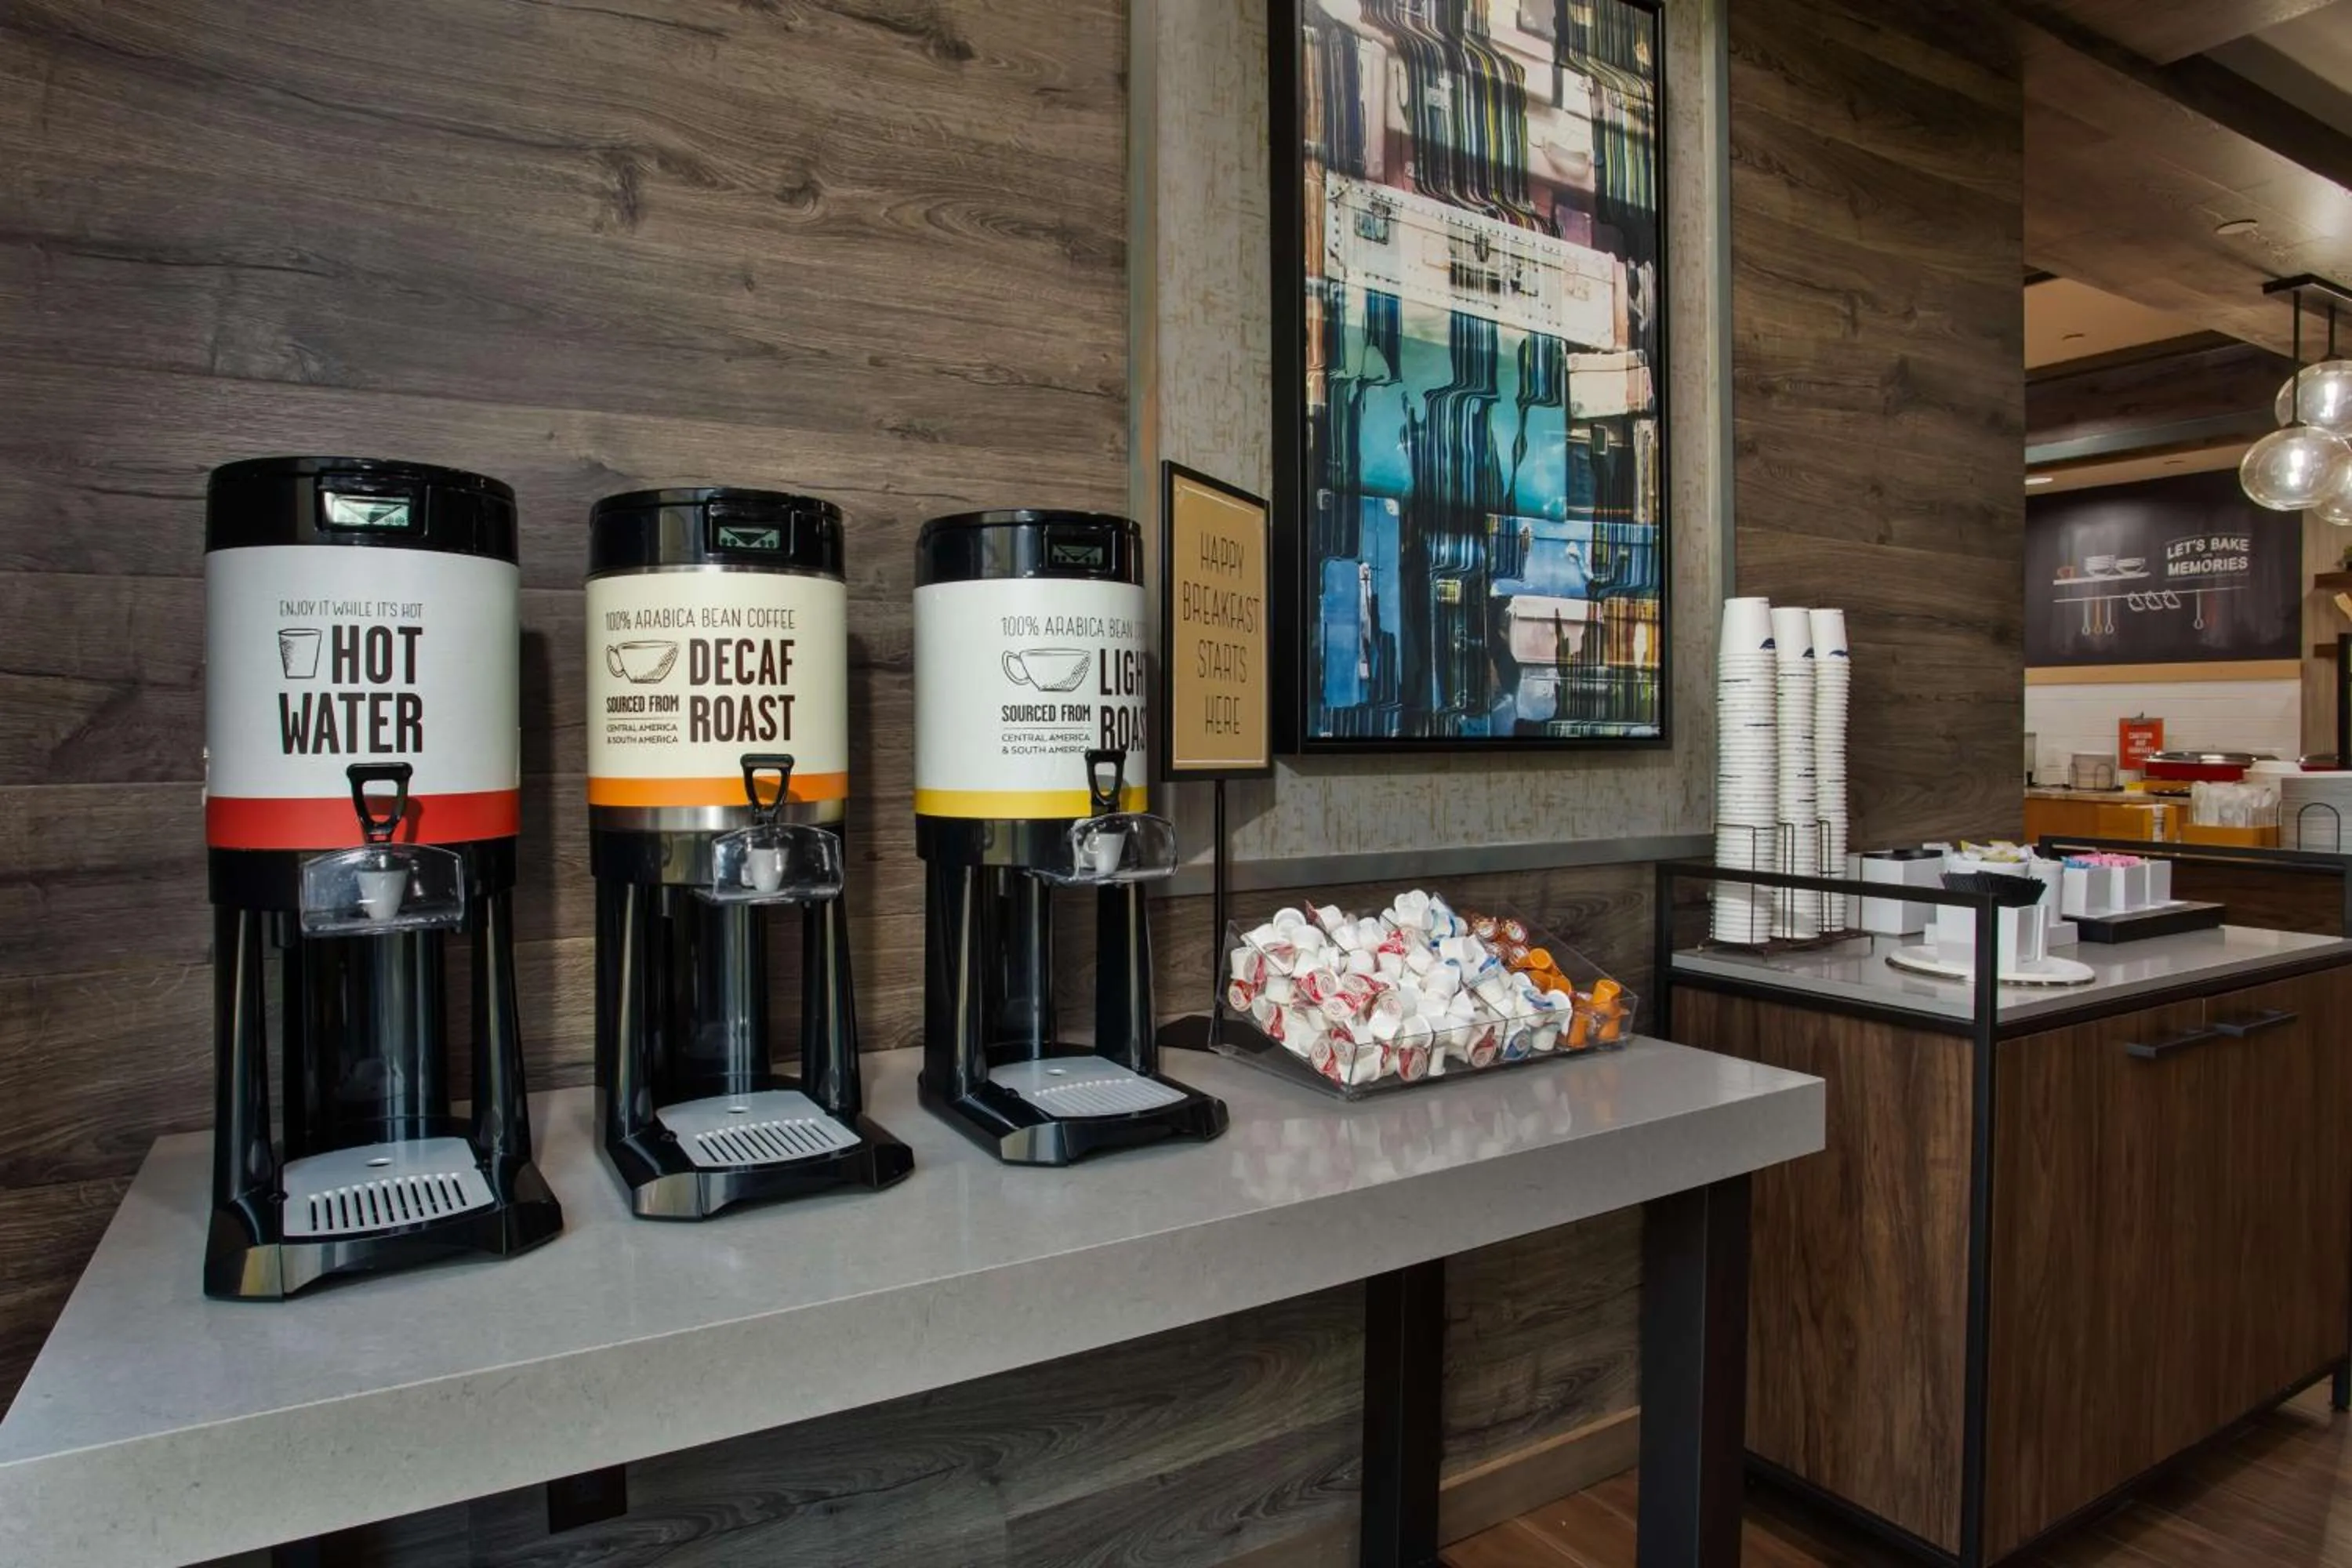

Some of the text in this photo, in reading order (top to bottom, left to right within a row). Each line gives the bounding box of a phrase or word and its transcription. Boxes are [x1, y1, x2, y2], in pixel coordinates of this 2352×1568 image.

[1200, 531, 1244, 579] HAPPY
[2166, 537, 2249, 560] LET'S BAKE
[2167, 556, 2249, 577] MEMORIES
[279, 600, 423, 619] ENJOY IT WHILE IT'S HOT
[606, 608, 796, 631] 100% ARABICA BEAN COFFEE
[1182, 580, 1261, 633] BREAKFAST
[1000, 615, 1040, 637] 100%
[1044, 615, 1105, 637] ARABICA
[1109, 618, 1133, 639] BEAN
[332, 625, 423, 684] HOT
[689, 637, 796, 686] DECAF
[1197, 639, 1247, 684] STARTS
[1100, 648, 1147, 696] LIGH
[606, 694, 680, 713] SOURCED FROM
[689, 694, 796, 743] ROAST
[1001, 704, 1091, 722] SOURCED FROM
[1205, 695, 1241, 735] HERE
[278, 692, 423, 755] WATER
[639, 723, 678, 731] AMERICA
[1001, 733, 1091, 742] CENTRAL AMERICA
[1100, 705, 1147, 752] ROAS
[1011, 746, 1047, 754] SOUTH
